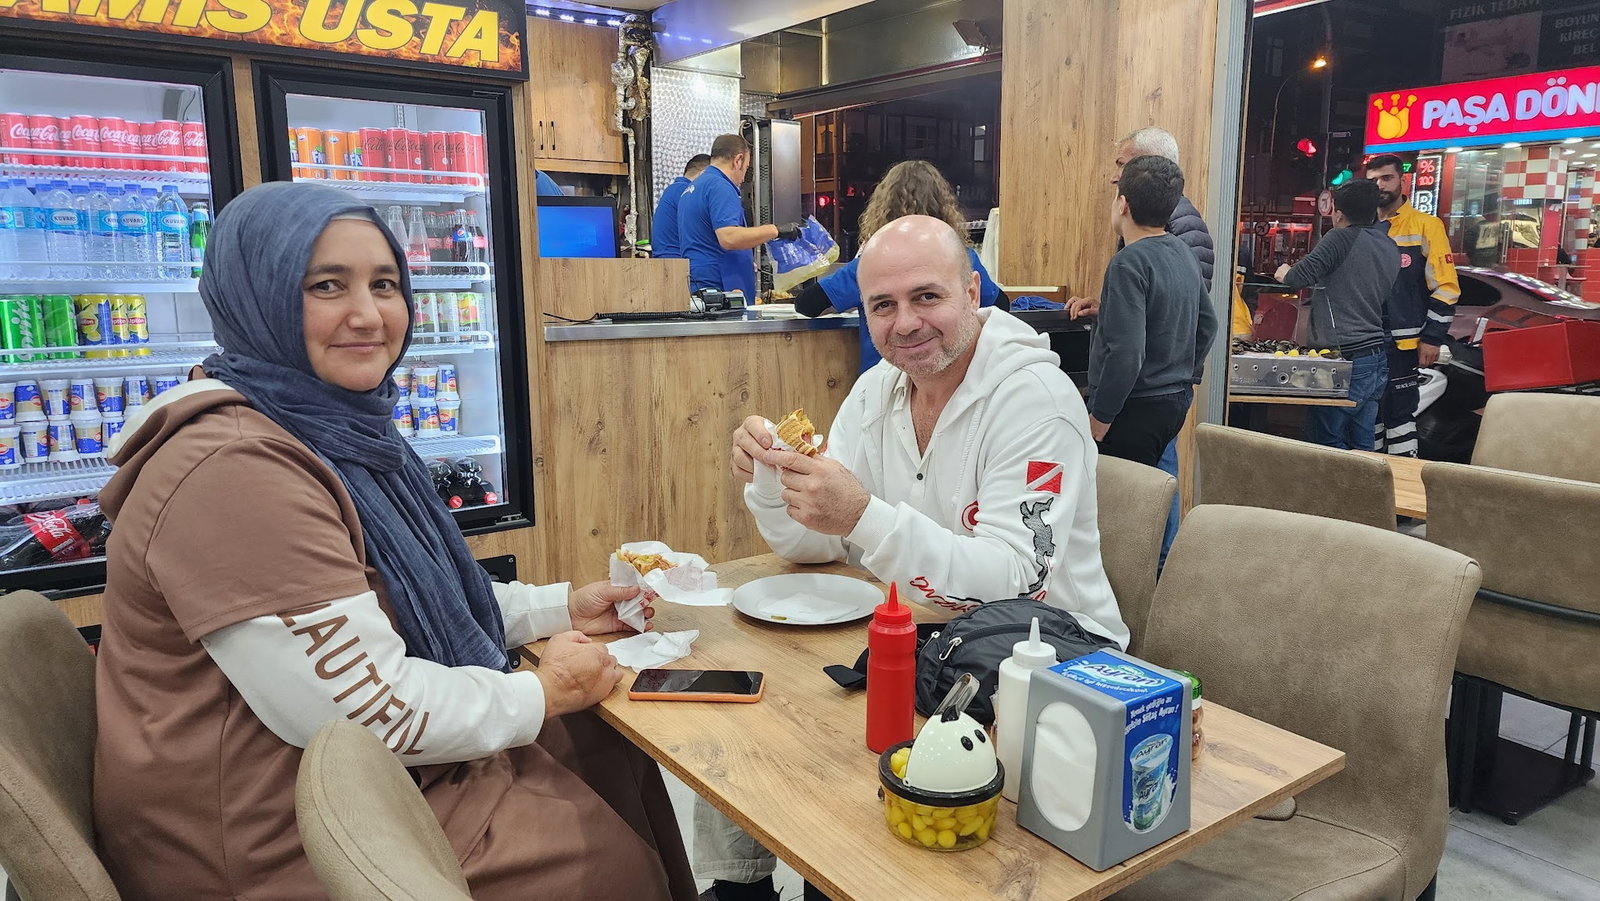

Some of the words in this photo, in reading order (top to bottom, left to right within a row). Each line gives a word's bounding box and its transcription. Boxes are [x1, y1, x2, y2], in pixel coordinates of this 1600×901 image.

[298, 0, 500, 63] USTA
[1422, 93, 1510, 133] PAŞA
[1515, 76, 1600, 121] DÖN
[1083, 663, 1161, 687] Ayran
